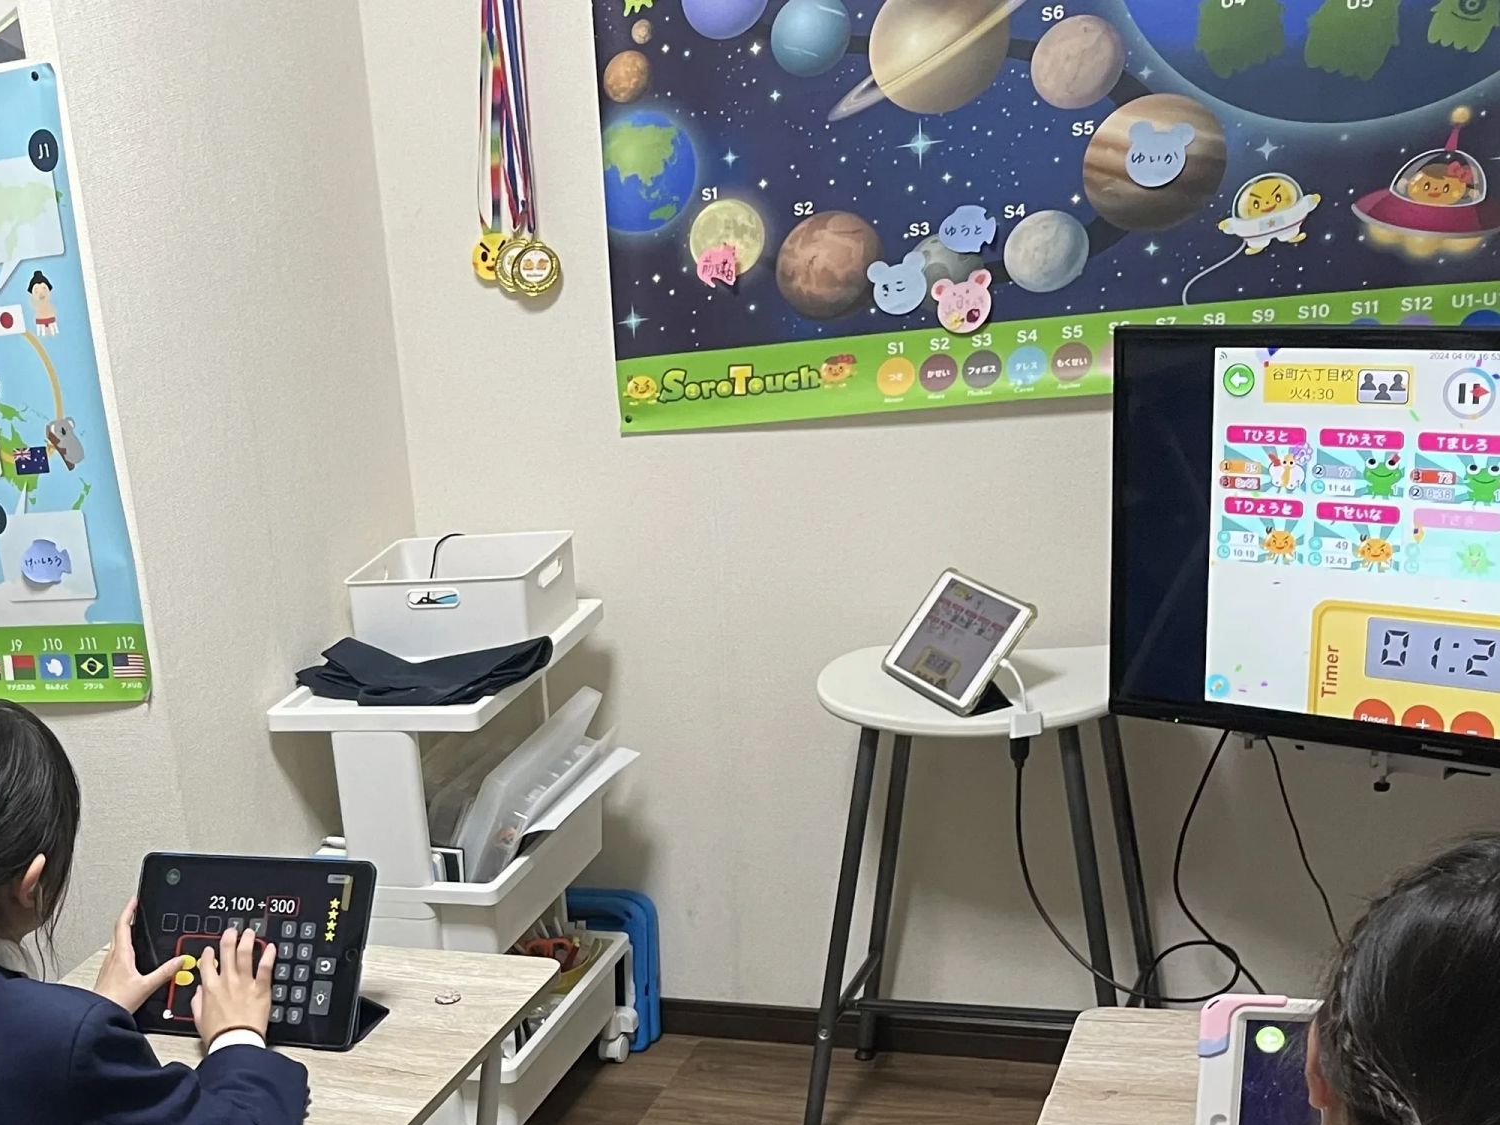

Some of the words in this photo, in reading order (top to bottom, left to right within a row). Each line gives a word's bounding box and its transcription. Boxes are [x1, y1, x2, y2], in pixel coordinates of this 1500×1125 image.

[1041, 6, 1064, 21] S6
[1071, 121, 1095, 137] S5
[37, 143, 50, 158] J1
[1131, 151, 1178, 165] ゆいか
[701, 188, 718, 201] S1
[794, 202, 813, 216] S2
[1004, 204, 1026, 219] S4
[909, 221, 930, 236] S3
[945, 225, 982, 236] ゆうと
[1297, 304, 1330, 319] S10
[1351, 300, 1379, 315] S11
[1401, 297, 1433, 312] S12
[1203, 312, 1226, 325] S8
[1251, 308, 1275, 324] S9
[1017, 329, 1037, 343] S4
[1062, 325, 1083, 339] S5
[930, 337, 950, 351] S2
[972, 333, 992, 347] S3
[887, 341, 904, 354] S1
[967, 365, 996, 375] フォボス
[1056, 358, 1088, 368] もくせい
[1273, 368, 1354, 381] 谷町六丁目校
[658, 364, 820, 403] SoroTouch
[1290, 387, 1334, 400] 火4:30
[1243, 429, 1289, 442] Tひろと
[1337, 432, 1387, 446] Tかえで
[1437, 437, 1488, 451] Tましろ
[1234, 501, 1293, 515] Tりょうと
[1333, 507, 1382, 521] Tせいな
[1243, 534, 1255, 543] 57
[1335, 541, 1348, 550] 49
[11, 639, 23, 652] J9
[43, 638, 63, 651] J10
[79, 637, 97, 650] J11
[116, 636, 135, 650] J12
[1321, 645, 1339, 698] Timer
[208, 896, 254, 912] 23,100
[270, 899, 295, 914] 300
